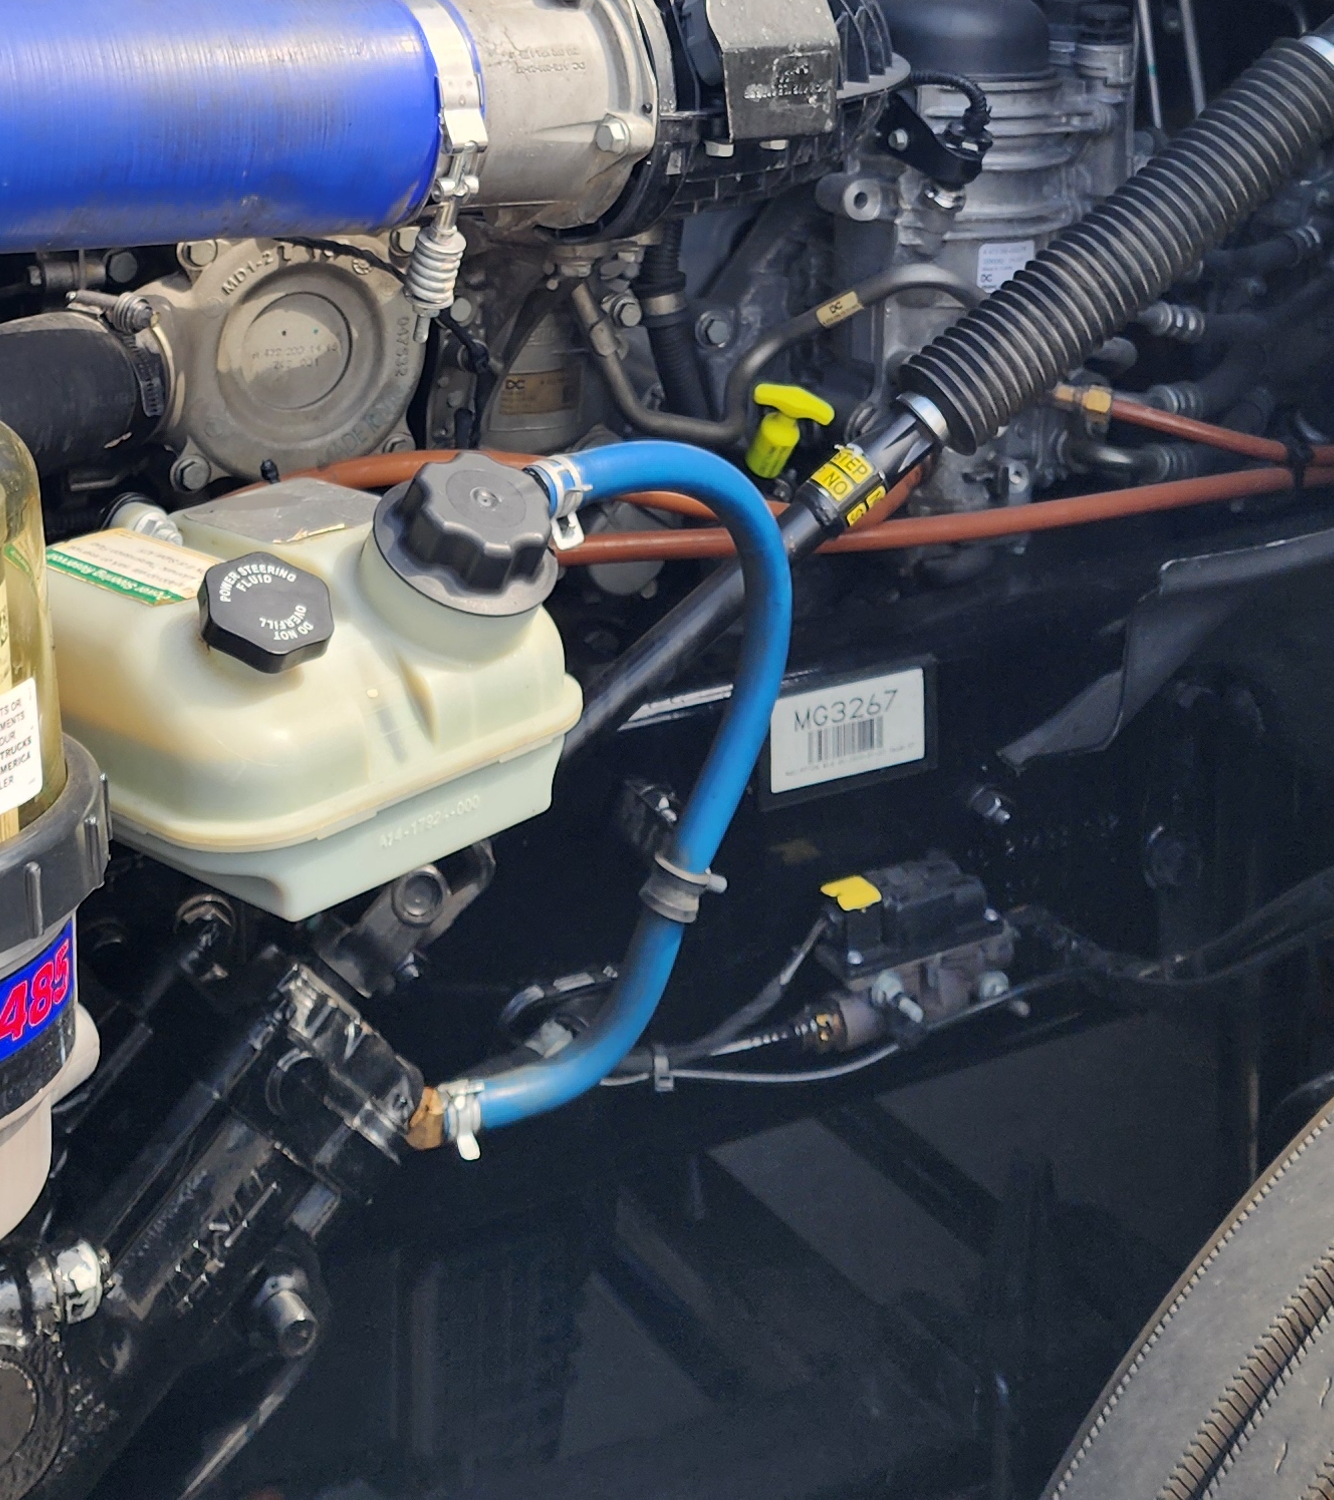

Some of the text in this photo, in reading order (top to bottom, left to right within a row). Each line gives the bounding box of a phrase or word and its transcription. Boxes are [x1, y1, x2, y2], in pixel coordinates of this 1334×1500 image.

[219, 564, 296, 602] POWER STEERING
[236, 574, 272, 592] FLUID
[259, 605, 306, 630] OVERFILL
[273, 621, 314, 641] DO NOT
[10, 697, 22, 712] OR
[794, 688, 899, 732] MG3267
[0, 735, 32, 760] TRUCKS
